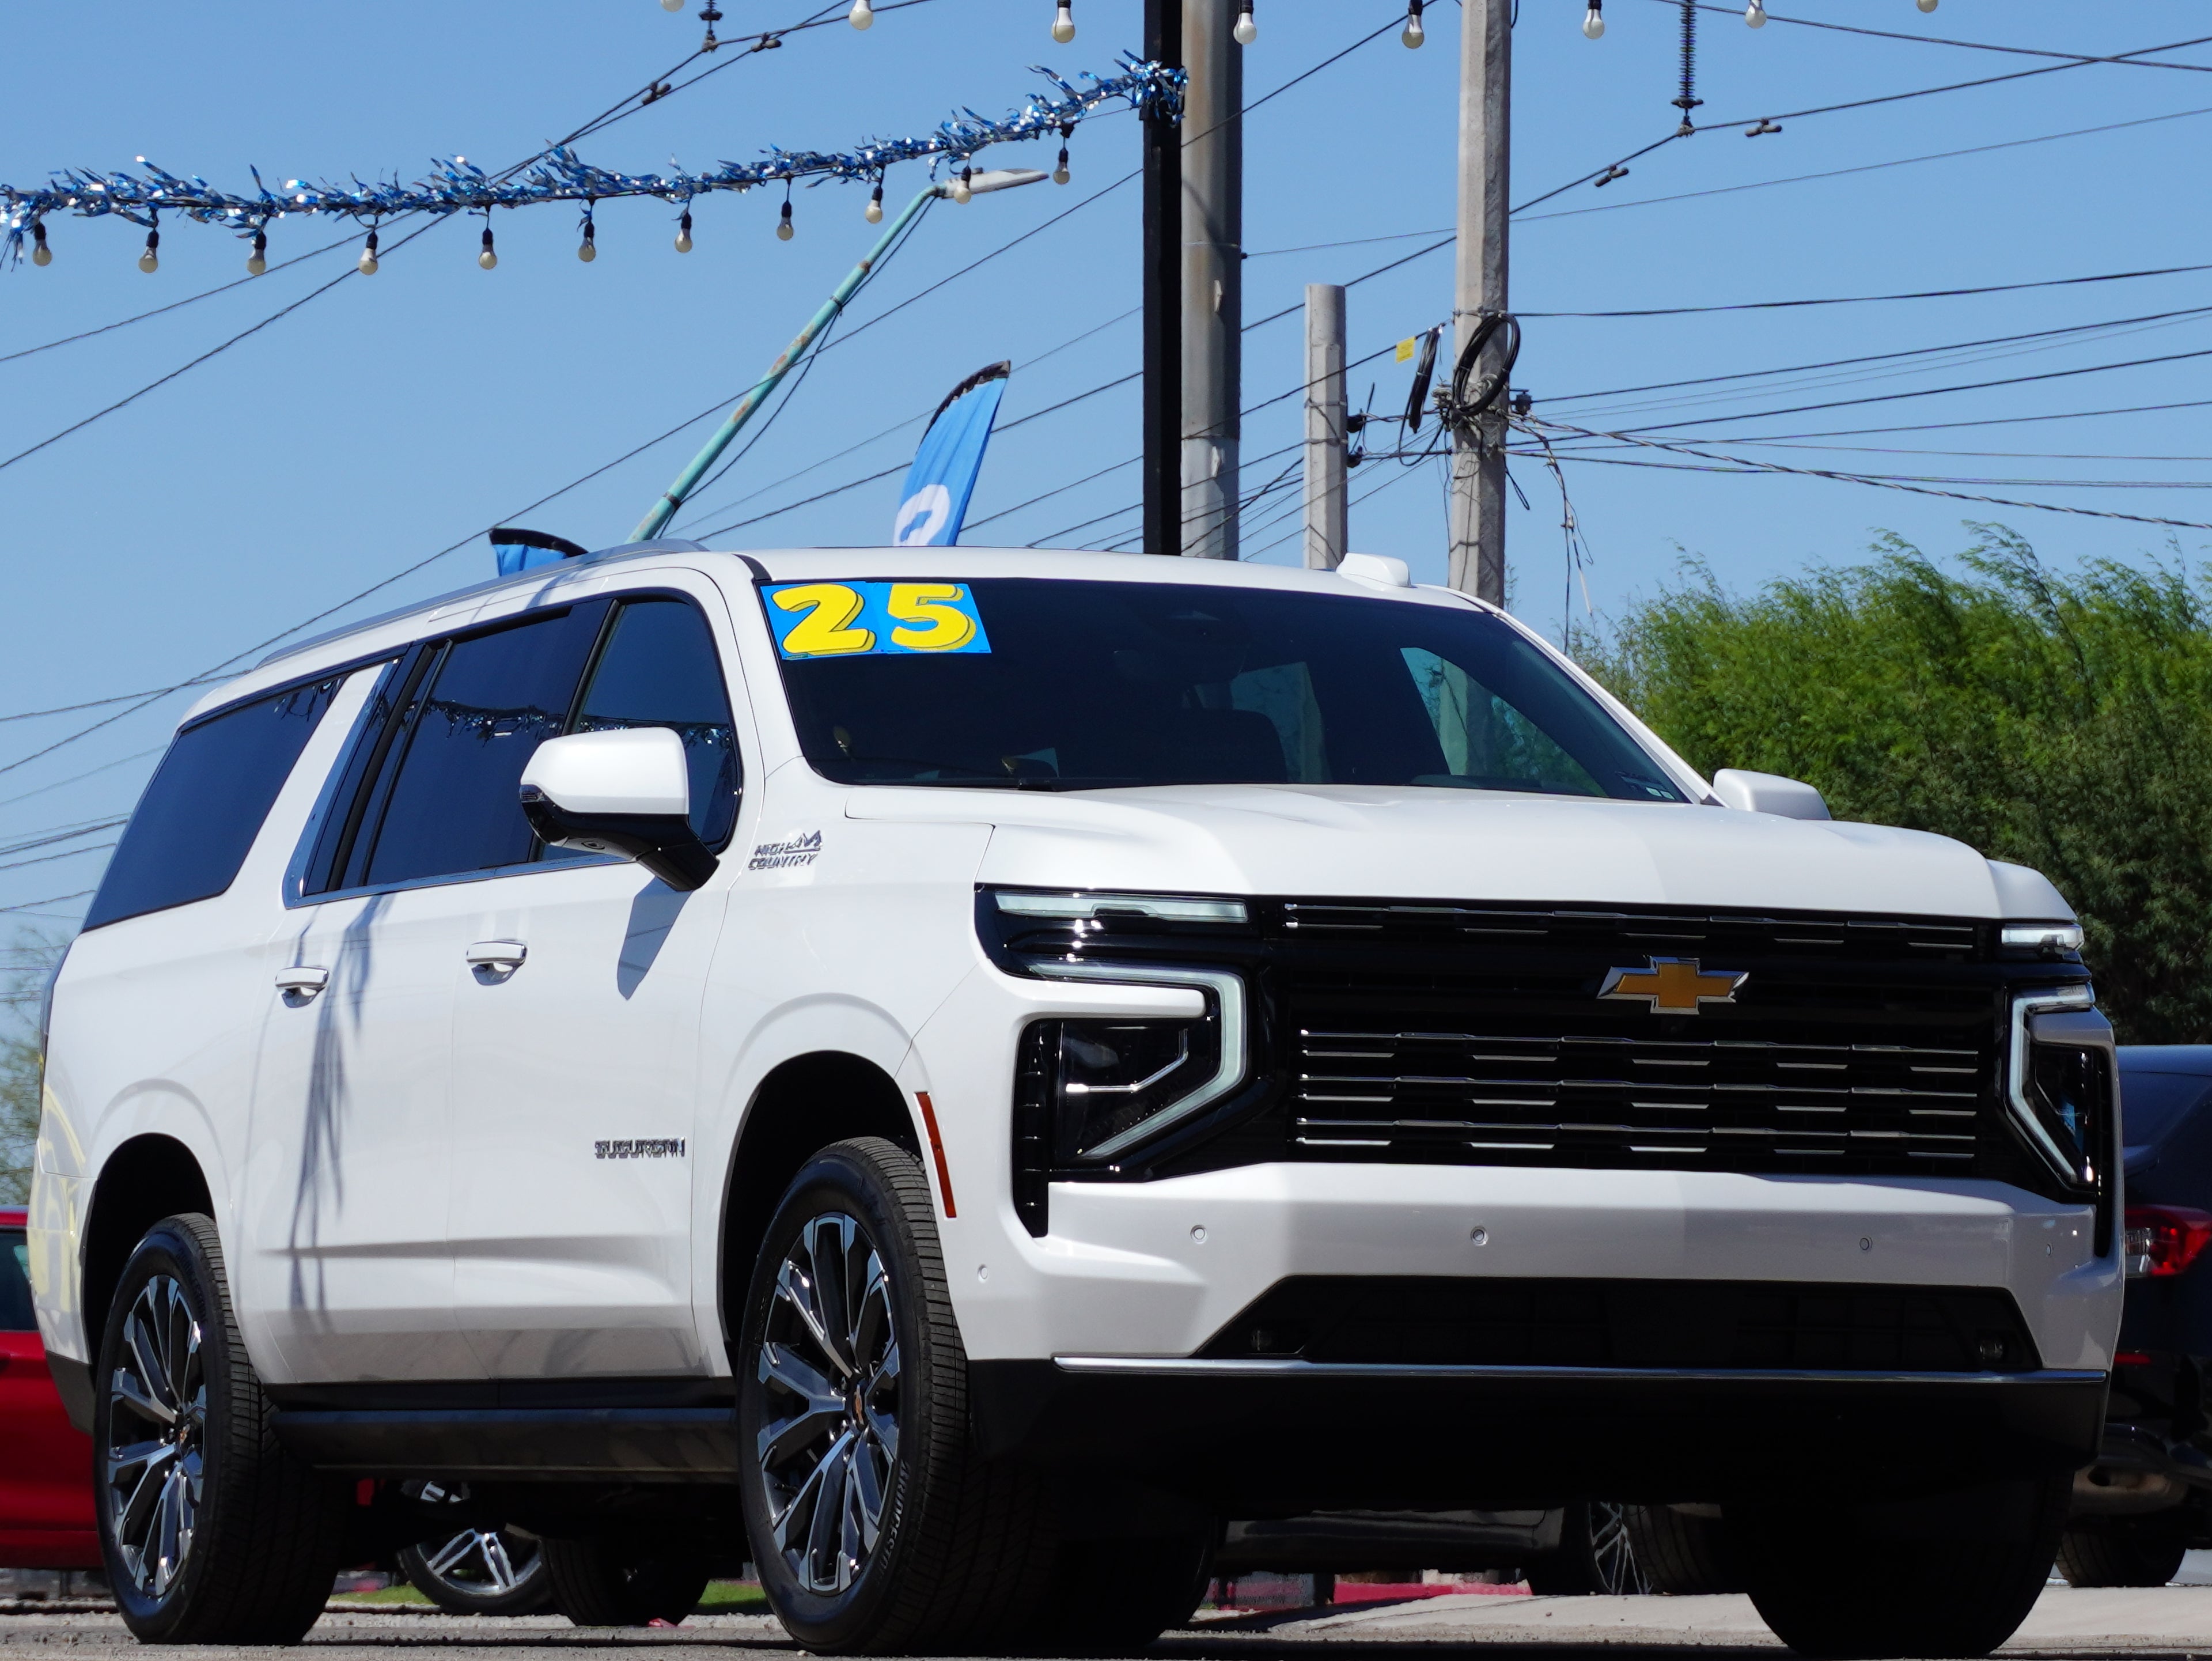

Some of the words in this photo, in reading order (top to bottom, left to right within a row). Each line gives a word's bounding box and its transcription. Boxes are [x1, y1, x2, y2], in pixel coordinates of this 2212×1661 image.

[772, 584, 976, 655] 25
[749, 853, 817, 871] COUNTRY
[595, 1137, 685, 1159] SUBURBAN
[877, 1459, 911, 1583] BRIDGESTO
